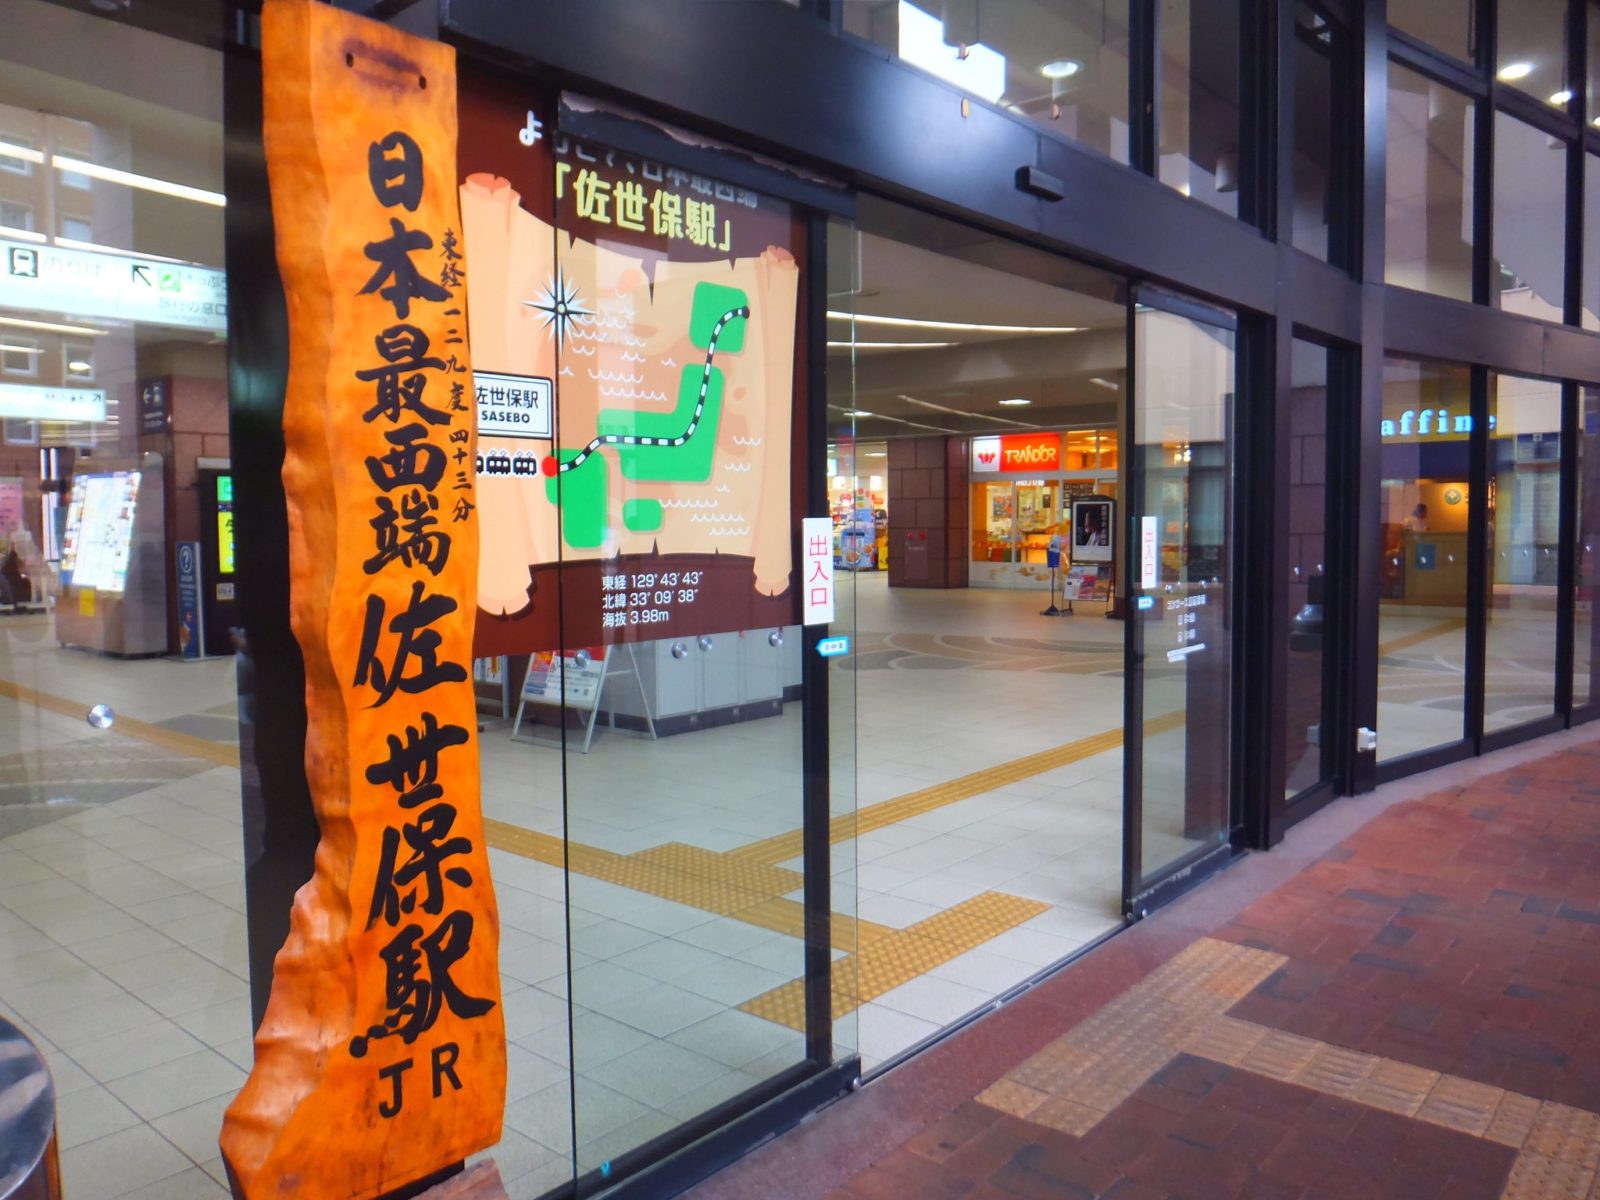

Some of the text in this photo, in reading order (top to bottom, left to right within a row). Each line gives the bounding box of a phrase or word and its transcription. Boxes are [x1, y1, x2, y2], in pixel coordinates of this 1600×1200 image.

[556, 162, 730, 251] 「佐世保駅」
[440, 227, 476, 523] 東経一二九度四十三分
[481, 410, 531, 423] SASEBO
[349, 131, 495, 1057] 日本最西端佐世保駅
[602, 575, 626, 591] 東経
[602, 593, 626, 609] 北緯
[809, 535, 828, 607] 出入口
[630, 609, 669, 624] 3.98m
[379, 1044, 463, 1118] JR
